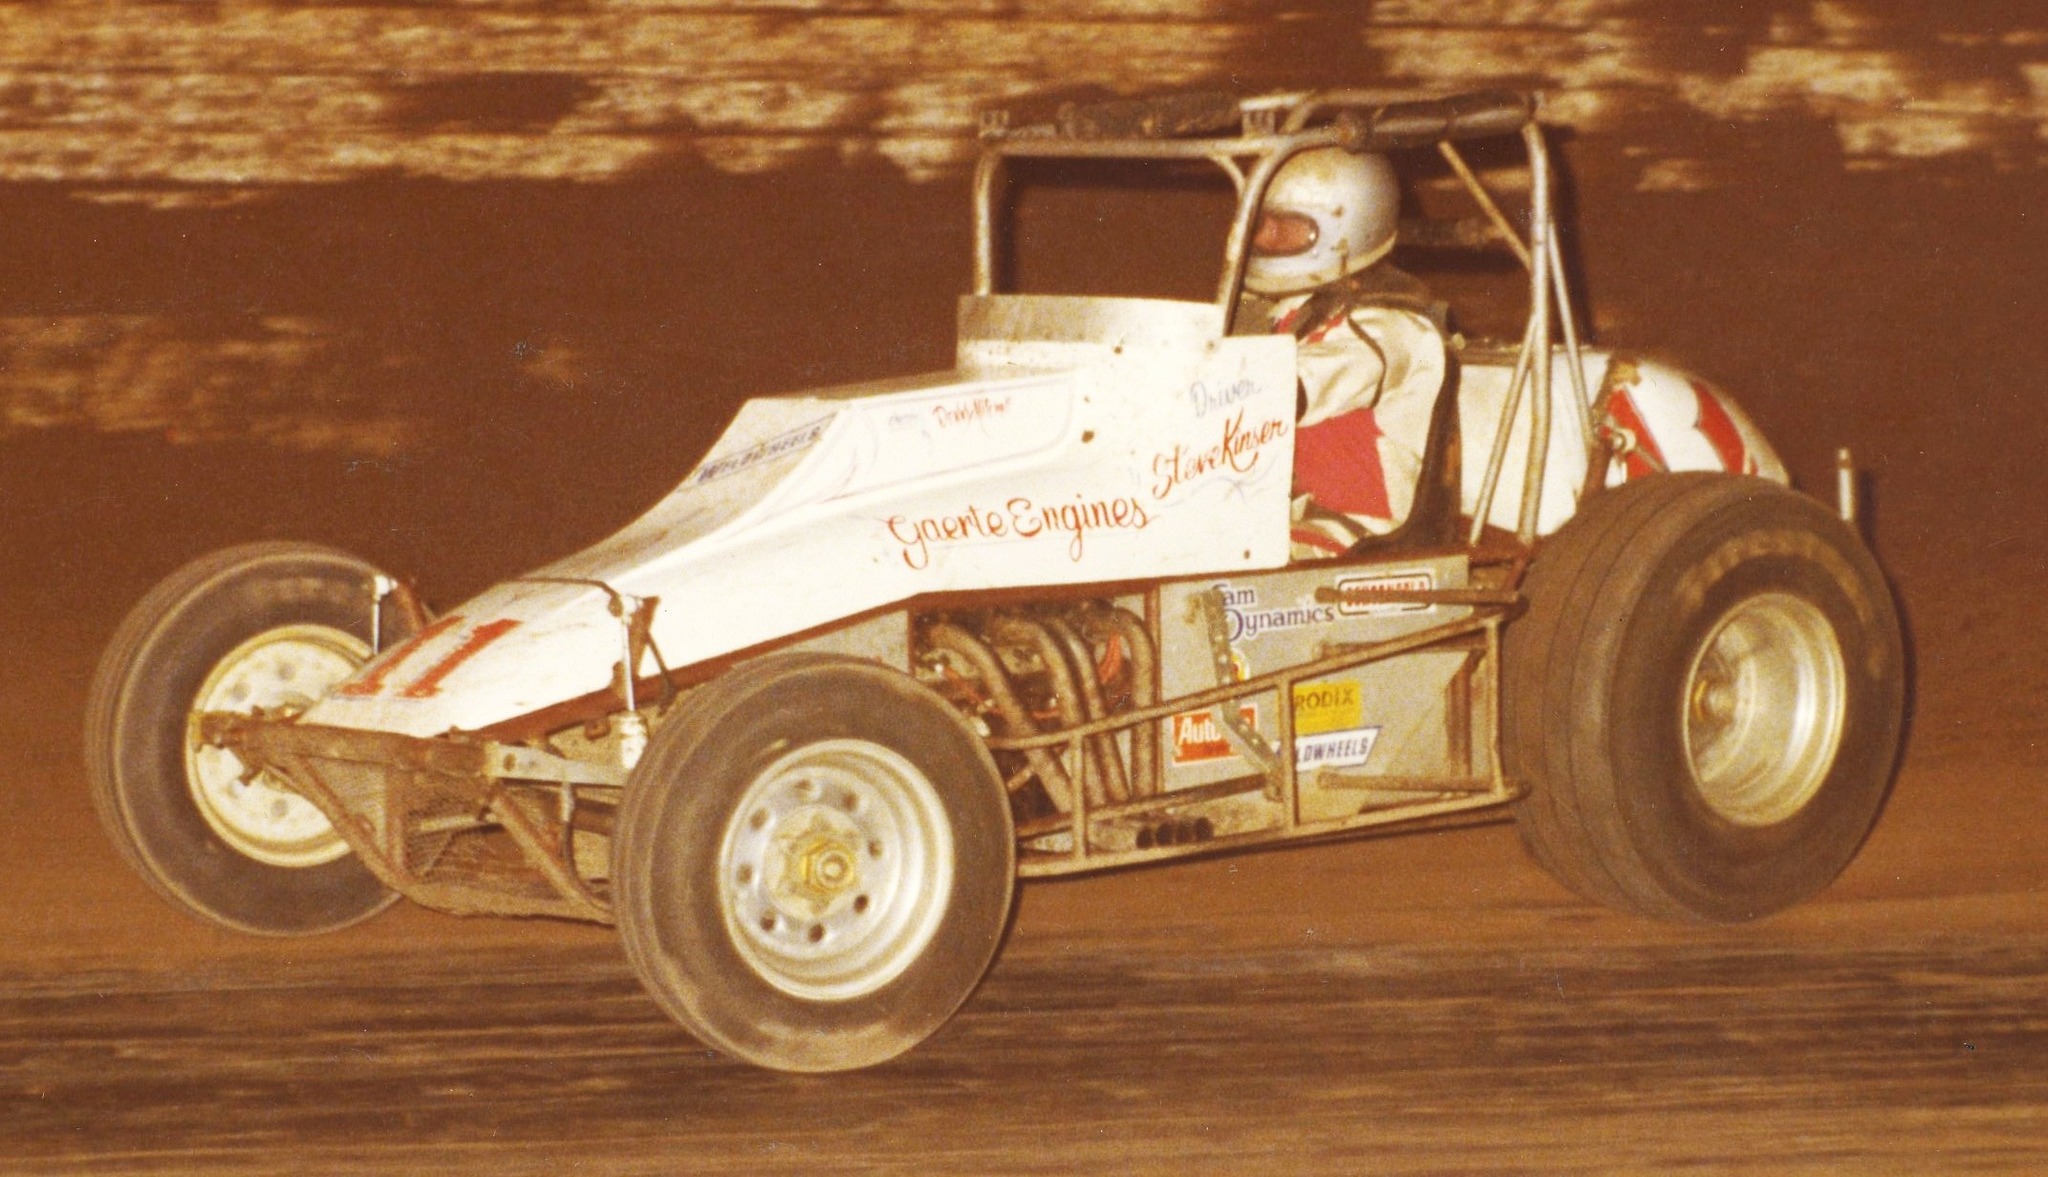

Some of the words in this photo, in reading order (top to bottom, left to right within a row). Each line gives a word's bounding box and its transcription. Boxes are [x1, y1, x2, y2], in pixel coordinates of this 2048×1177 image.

[1189, 375, 1262, 418] Driver
[1151, 443, 1222, 500] Steve
[1218, 406, 1288, 473] Kinser
[885, 504, 1008, 570] Gaerte
[1006, 494, 1155, 563] Engines
[1294, 686, 1356, 712] RODIX
